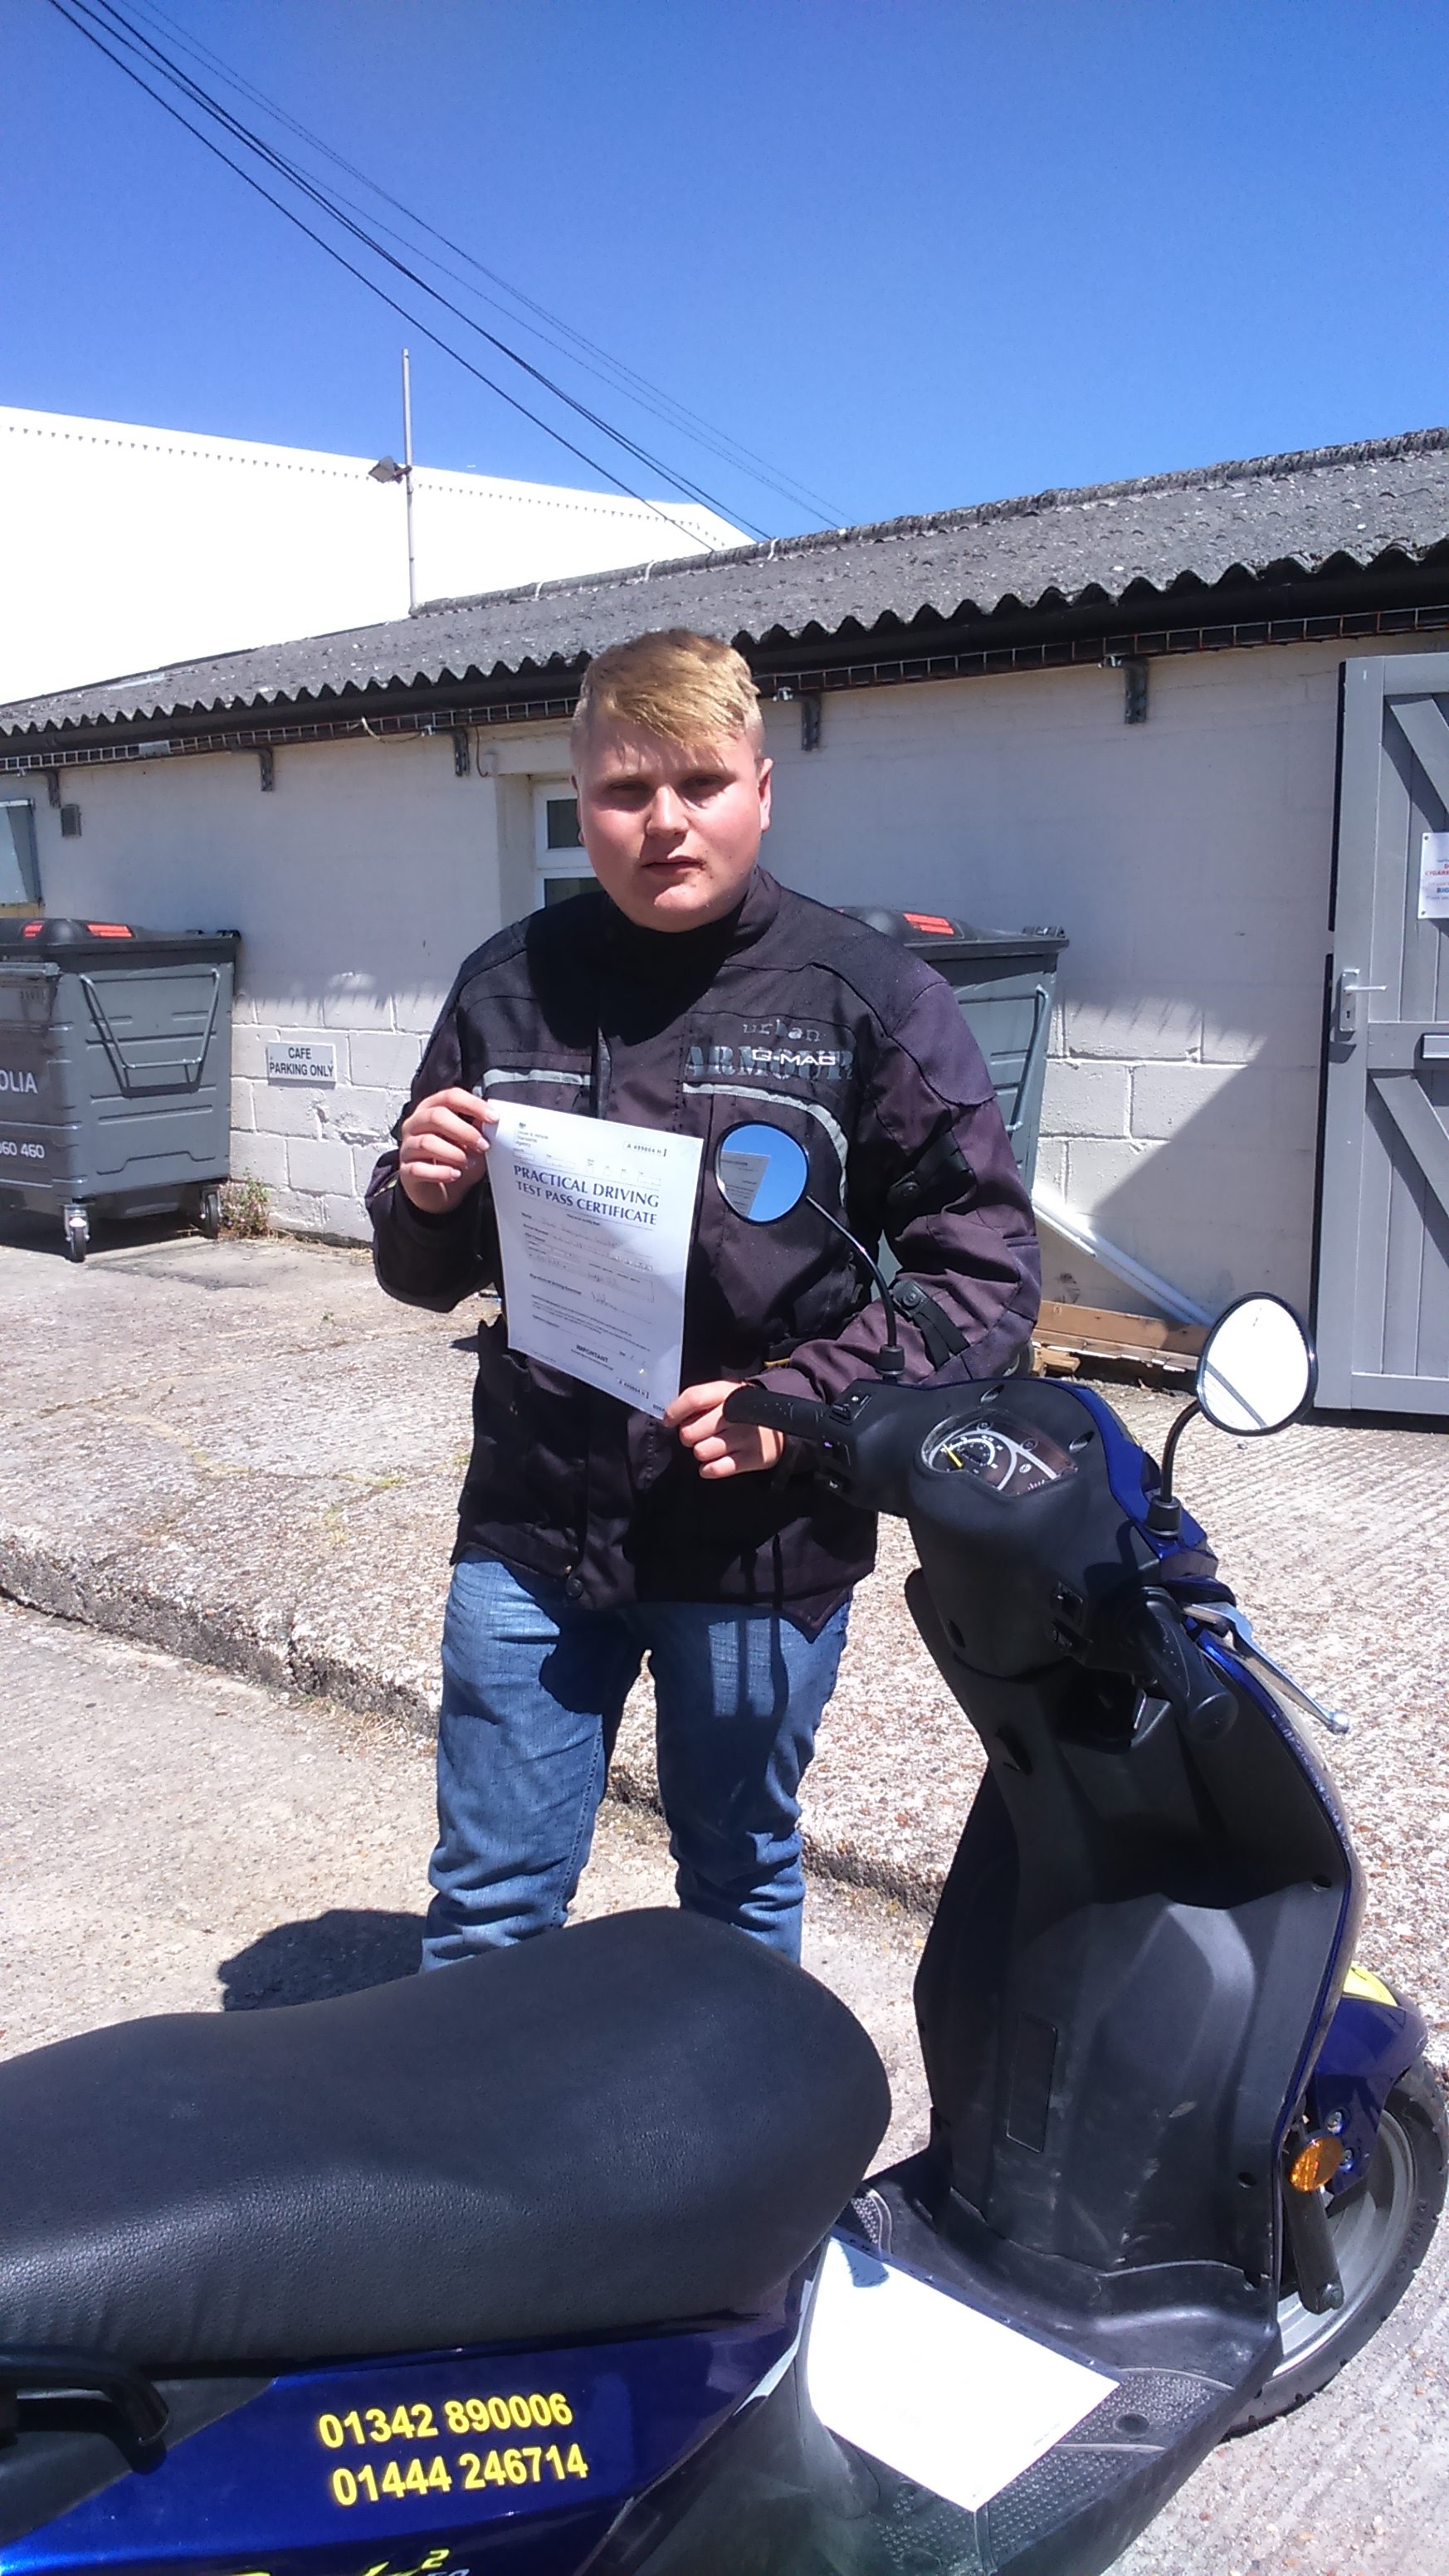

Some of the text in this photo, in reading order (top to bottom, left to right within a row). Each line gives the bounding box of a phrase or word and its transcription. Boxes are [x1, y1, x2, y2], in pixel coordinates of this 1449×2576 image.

[269, 1062, 334, 1077] PARKING ONLY
[288, 1047, 312, 1060] CAFE
[0, 1141, 45, 1159] 60 460
[513, 1164, 659, 1208] PRACTICAL DRIVING
[516, 1180, 541, 1197] TEST
[545, 1189, 573, 1207] PASS
[577, 1198, 657, 1226] CERTIFICATE
[319, 2393, 573, 2448] 01342 890006
[332, 2443, 589, 2506] 01444 246714
